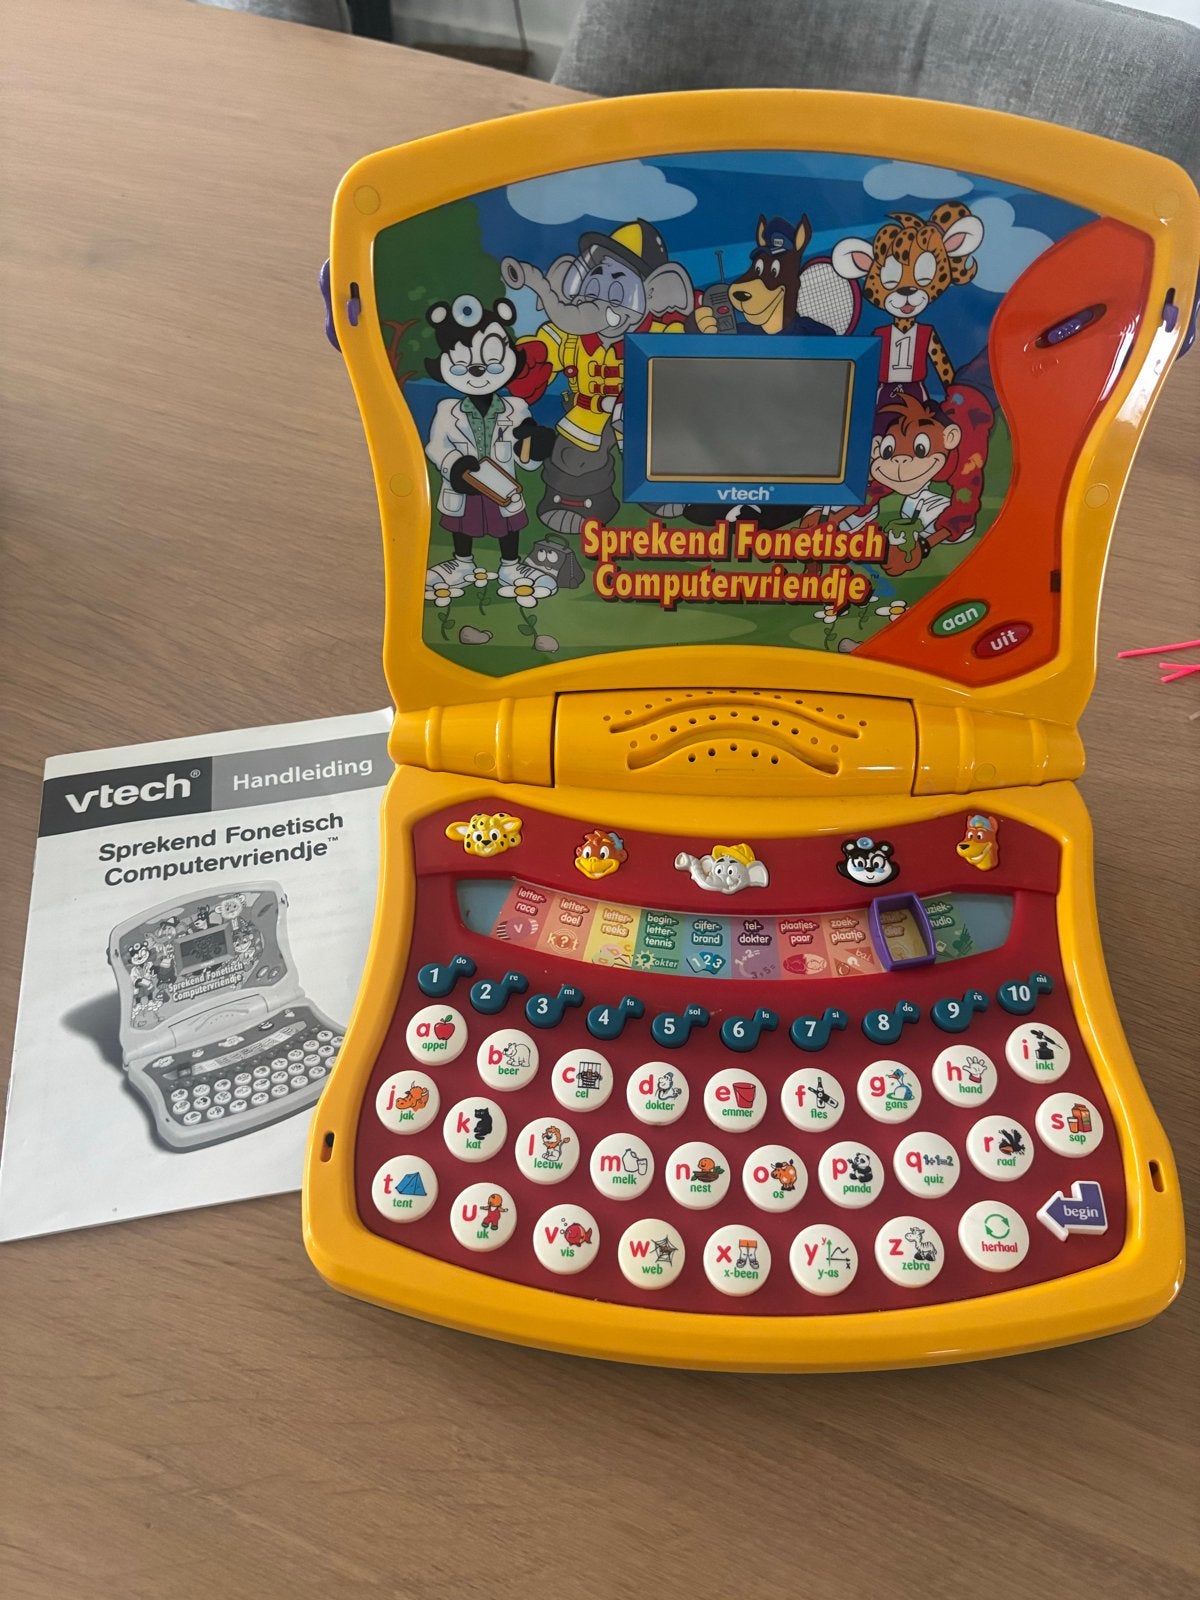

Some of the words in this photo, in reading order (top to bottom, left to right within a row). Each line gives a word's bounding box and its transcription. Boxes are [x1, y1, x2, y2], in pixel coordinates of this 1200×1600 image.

[892, 336, 912, 370] 1
[583, 521, 726, 560] Sprekend
[736, 523, 884, 559] Fonetisch
[943, 607, 979, 631] aan
[990, 629, 1018, 651] uit
[233, 758, 374, 791] Handleiding
[99, 829, 216, 863] Sprekend
[226, 812, 344, 843] Fonetisch
[518, 887, 545, 901] letter-
[516, 903, 536, 914] race
[561, 899, 588, 912] letter-
[924, 902, 951, 914] uziek-
[560, 913, 581, 925] doel
[604, 910, 631, 922] letter-
[647, 913, 677, 925] begin-
[831, 917, 857, 927] zoek-
[930, 916, 952, 928] tudio
[602, 925, 627, 936] reeks
[646, 925, 674, 936] letter-
[694, 920, 720, 932] cijfer-
[745, 920, 761, 930] tel-
[780, 920, 817, 933] plaatjes-
[645, 937, 673, 948] tennis
[693, 933, 720, 944] brand
[739, 933, 770, 944] dokter
[790, 934, 811, 944] paar
[831, 930, 863, 943] plaatje
[456, 956, 467, 965] do
[168, 974, 205, 993] Sprekend
[206, 962, 244, 980] Fonetisch
[430, 968, 440, 983] 1
[172, 973, 243, 1002] Computervriendje
[480, 984, 491, 1000] 2
[1007, 985, 1031, 1002] 10
[537, 998, 548, 1014] 3
[689, 1008, 701, 1016] sol
[947, 1002, 960, 1018] 9
[598, 1009, 609, 1025] 4
[762, 1011, 770, 1019] la
[664, 1018, 675, 1034] 5
[805, 1021, 816, 1037] 7
[877, 1014, 890, 1031] 8
[416, 1022, 430, 1037] a
[733, 1021, 745, 1038] 6
[422, 1040, 447, 1051] appel
[1022, 1039, 1029, 1060] i
[488, 1045, 503, 1065] b
[498, 1066, 519, 1075] beer
[946, 1060, 962, 1081] h
[1035, 1060, 1055, 1071] inkt
[562, 1067, 575, 1083] c
[638, 1074, 653, 1095] d
[869, 1076, 886, 1097] g
[959, 1084, 983, 1094] hand
[386, 1085, 396, 1111] j
[575, 1088, 588, 1098] cel
[715, 1085, 730, 1101] e
[795, 1085, 806, 1107] f
[645, 1100, 675, 1111] dokter
[885, 1101, 908, 1112] gans
[399, 1111, 414, 1122] jak
[722, 1108, 753, 1117] emmer
[811, 1108, 828, 1119] fles
[456, 1112, 470, 1133] k
[1050, 1113, 1065, 1130] s
[466, 1139, 482, 1149] kat
[983, 1136, 994, 1153] r
[1069, 1134, 1087, 1145] sap
[534, 1158, 563, 1170] leeuw
[600, 1155, 621, 1172] m
[906, 1151, 922, 1173] q
[997, 1157, 1017, 1167] raaf
[676, 1163, 690, 1180] n
[753, 1166, 769, 1183] o
[832, 1158, 848, 1180] p
[383, 1174, 394, 1194] t
[612, 1174, 637, 1185] melk
[924, 1173, 944, 1186] quiz
[690, 1183, 711, 1193] nest
[773, 1190, 784, 1199] os
[843, 1184, 872, 1195] panda
[393, 1198, 413, 1208] tent
[462, 1204, 477, 1221] u
[1063, 1204, 1099, 1220] begin
[476, 1228, 489, 1239] uk
[544, 1226, 559, 1244] v
[560, 1247, 575, 1257] vis
[629, 1240, 650, 1258] w
[889, 1238, 904, 1256] z
[981, 1241, 1019, 1253] herhaal
[716, 1245, 732, 1263] x
[804, 1243, 819, 1266] y
[642, 1264, 663, 1275] web
[902, 1260, 931, 1271] zebra
[724, 1268, 759, 1280] x-been
[818, 1269, 840, 1280] y-as
